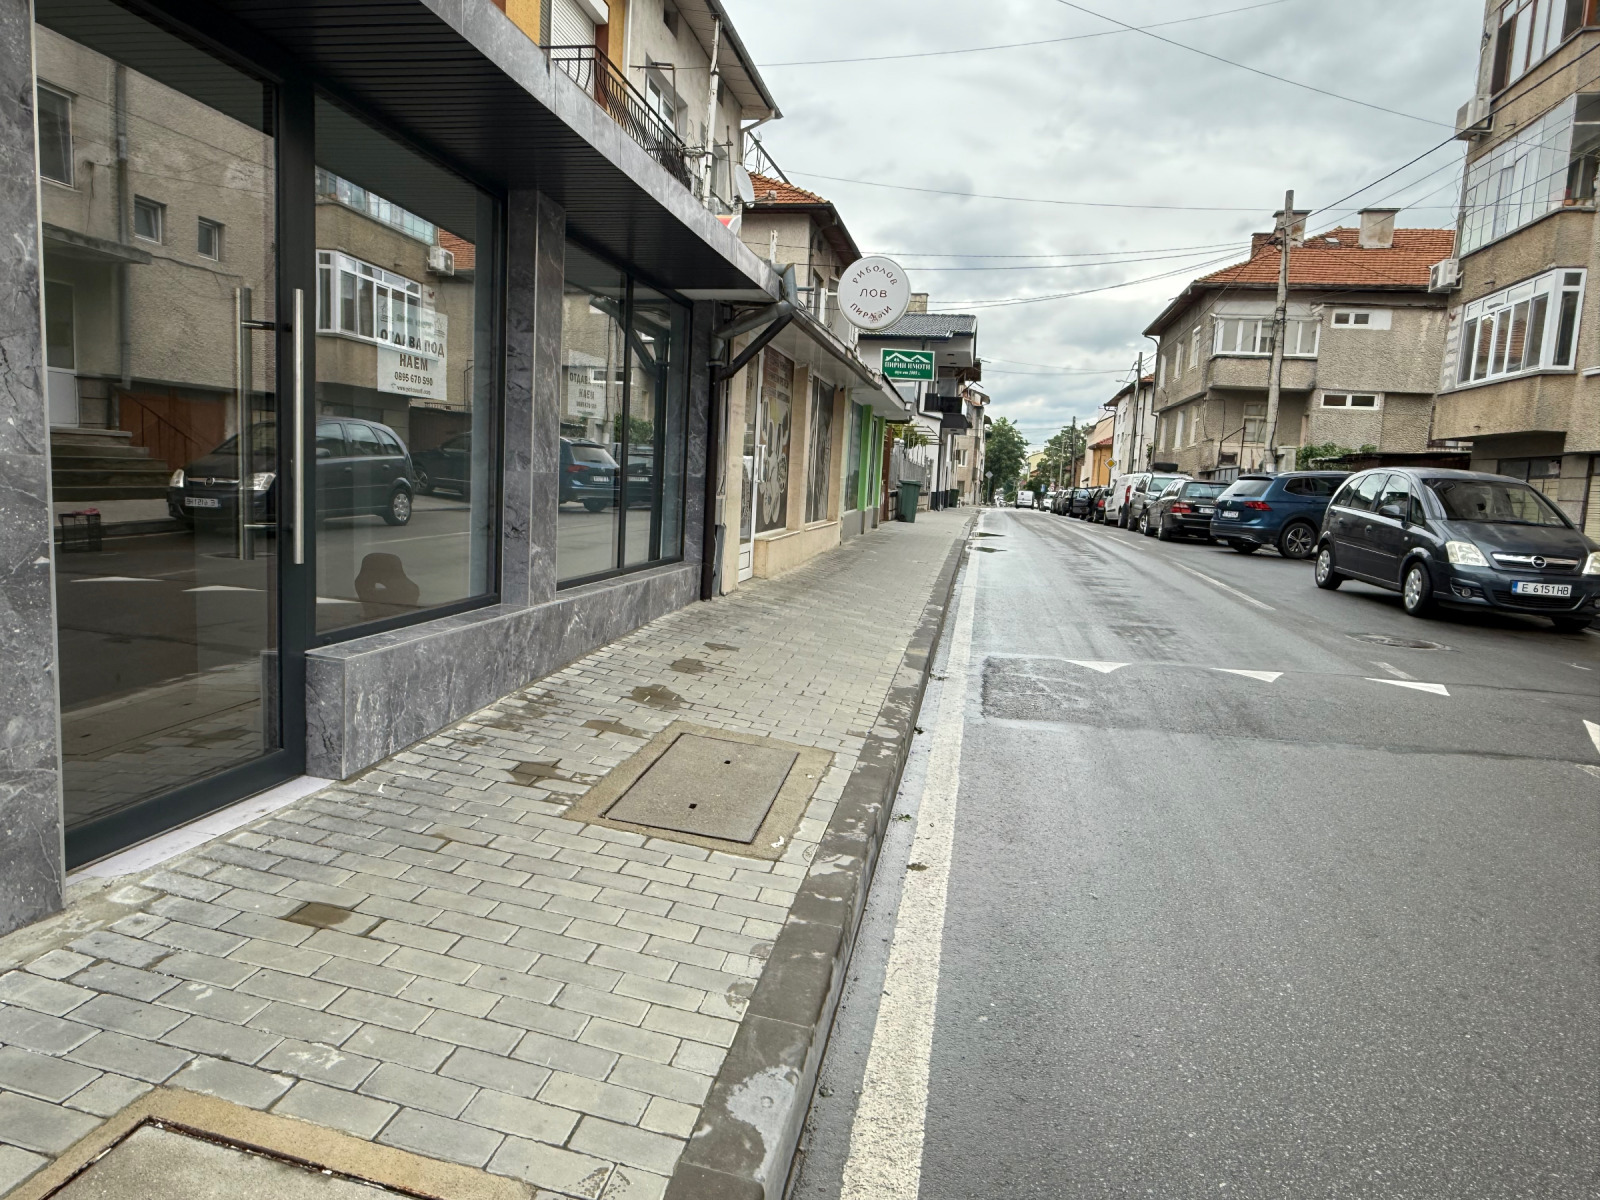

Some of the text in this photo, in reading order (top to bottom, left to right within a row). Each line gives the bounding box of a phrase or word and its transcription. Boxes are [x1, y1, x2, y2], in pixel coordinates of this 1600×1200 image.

[852, 265, 898, 285] РИБОЛОВ
[859, 288, 887, 298] ЛОВ
[424, 340, 445, 358] ПОД
[399, 353, 428, 372] НАЕМ
[884, 361, 907, 369] ПИРИН
[410, 374, 421, 384] 670
[422, 376, 433, 386] 590
[1521, 583, 1529, 592] E
